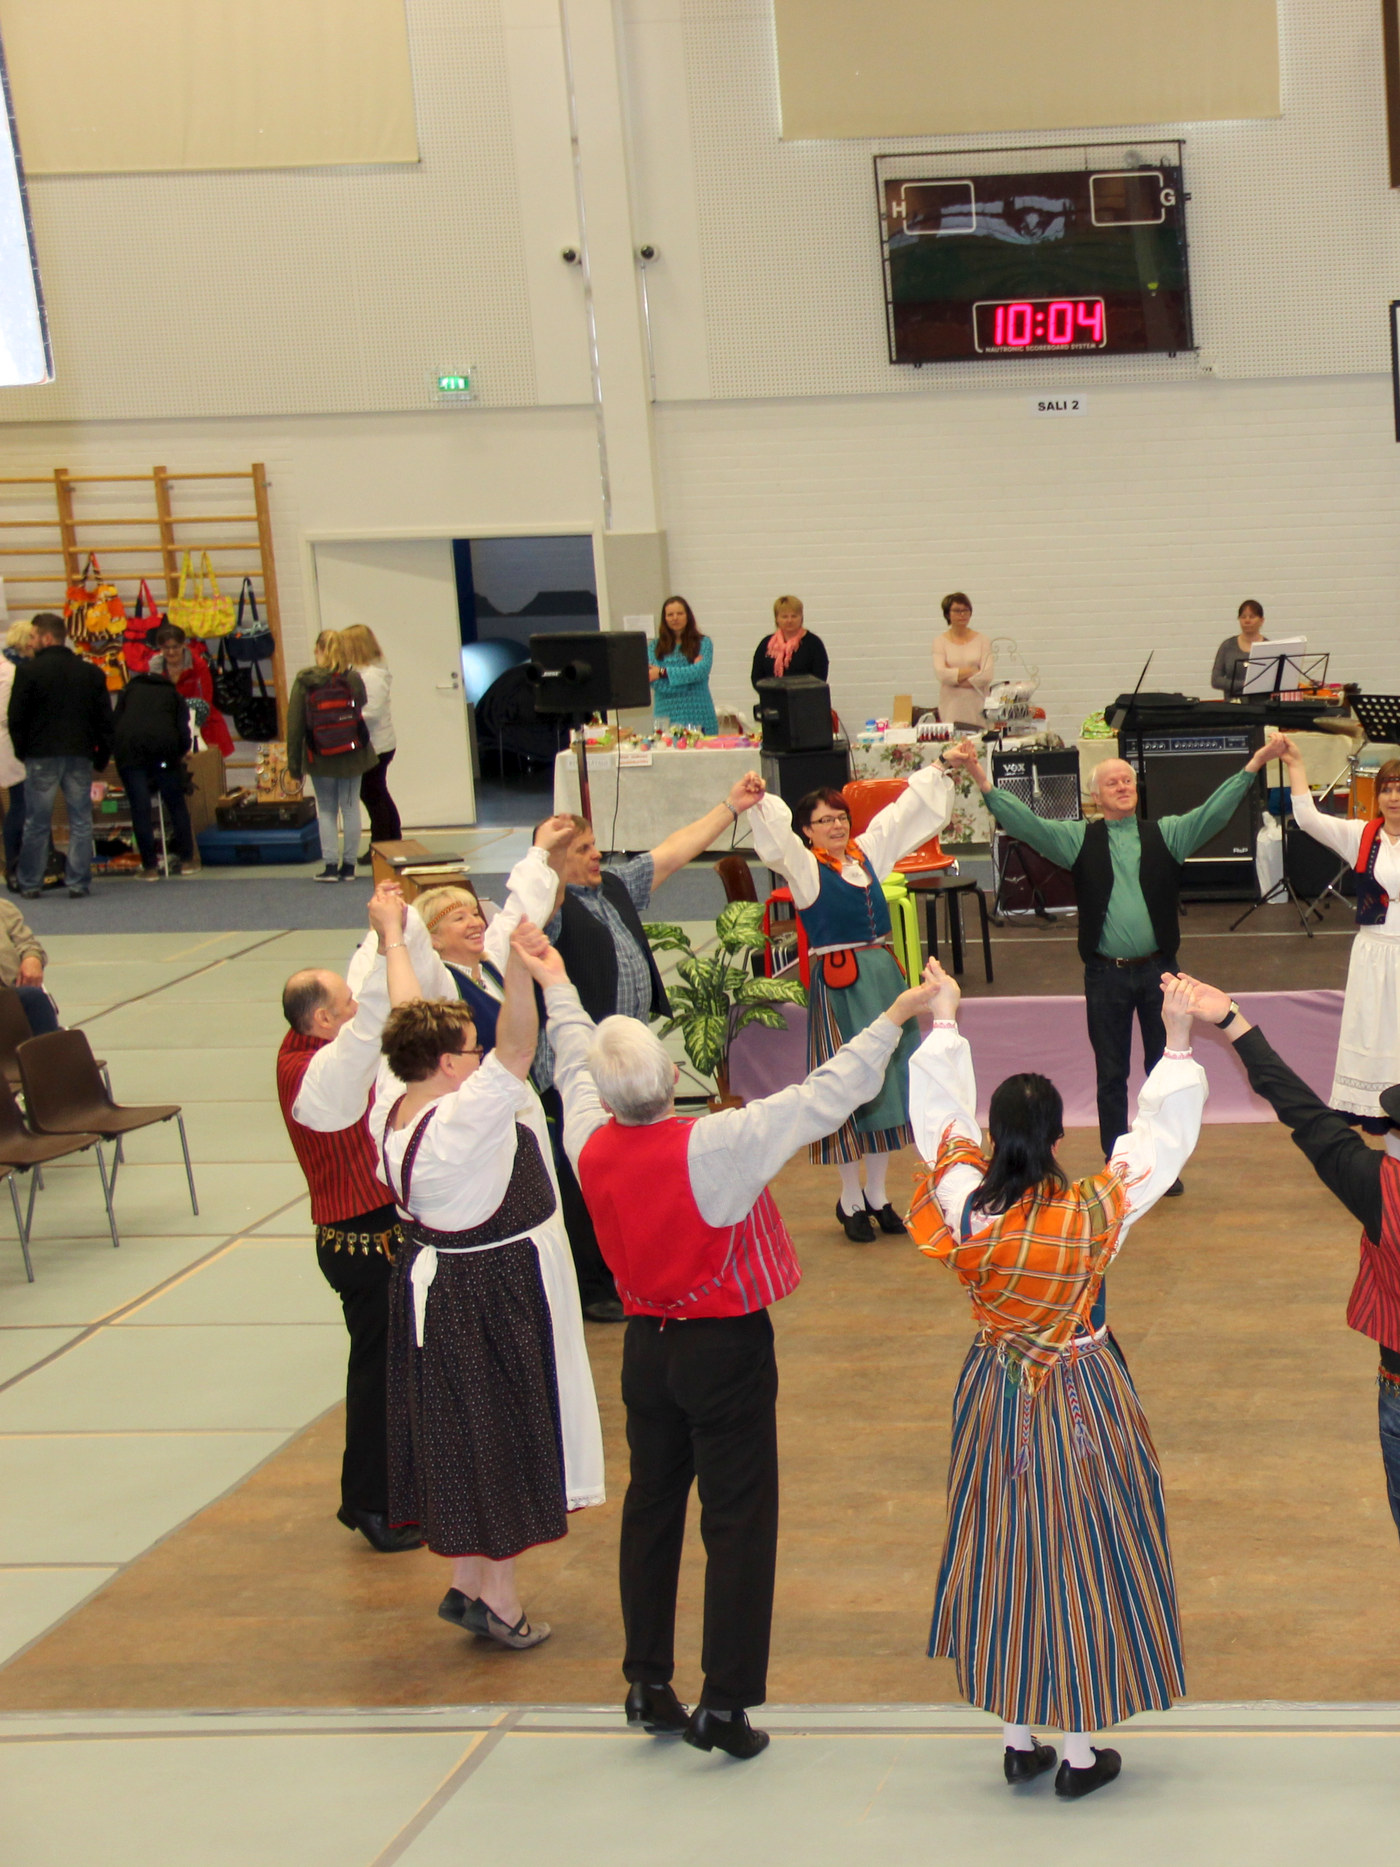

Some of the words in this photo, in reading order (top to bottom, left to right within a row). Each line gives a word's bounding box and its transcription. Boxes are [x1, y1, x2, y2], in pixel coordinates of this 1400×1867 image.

[1159, 188, 1175, 206] G
[892, 201, 906, 219] H
[994, 301, 1103, 346] 10:04
[1025, 344, 1069, 352] SCOREBOARD
[1038, 401, 1067, 412] SALI
[1071, 400, 1079, 410] 2
[1003, 763, 1025, 772] VOX
